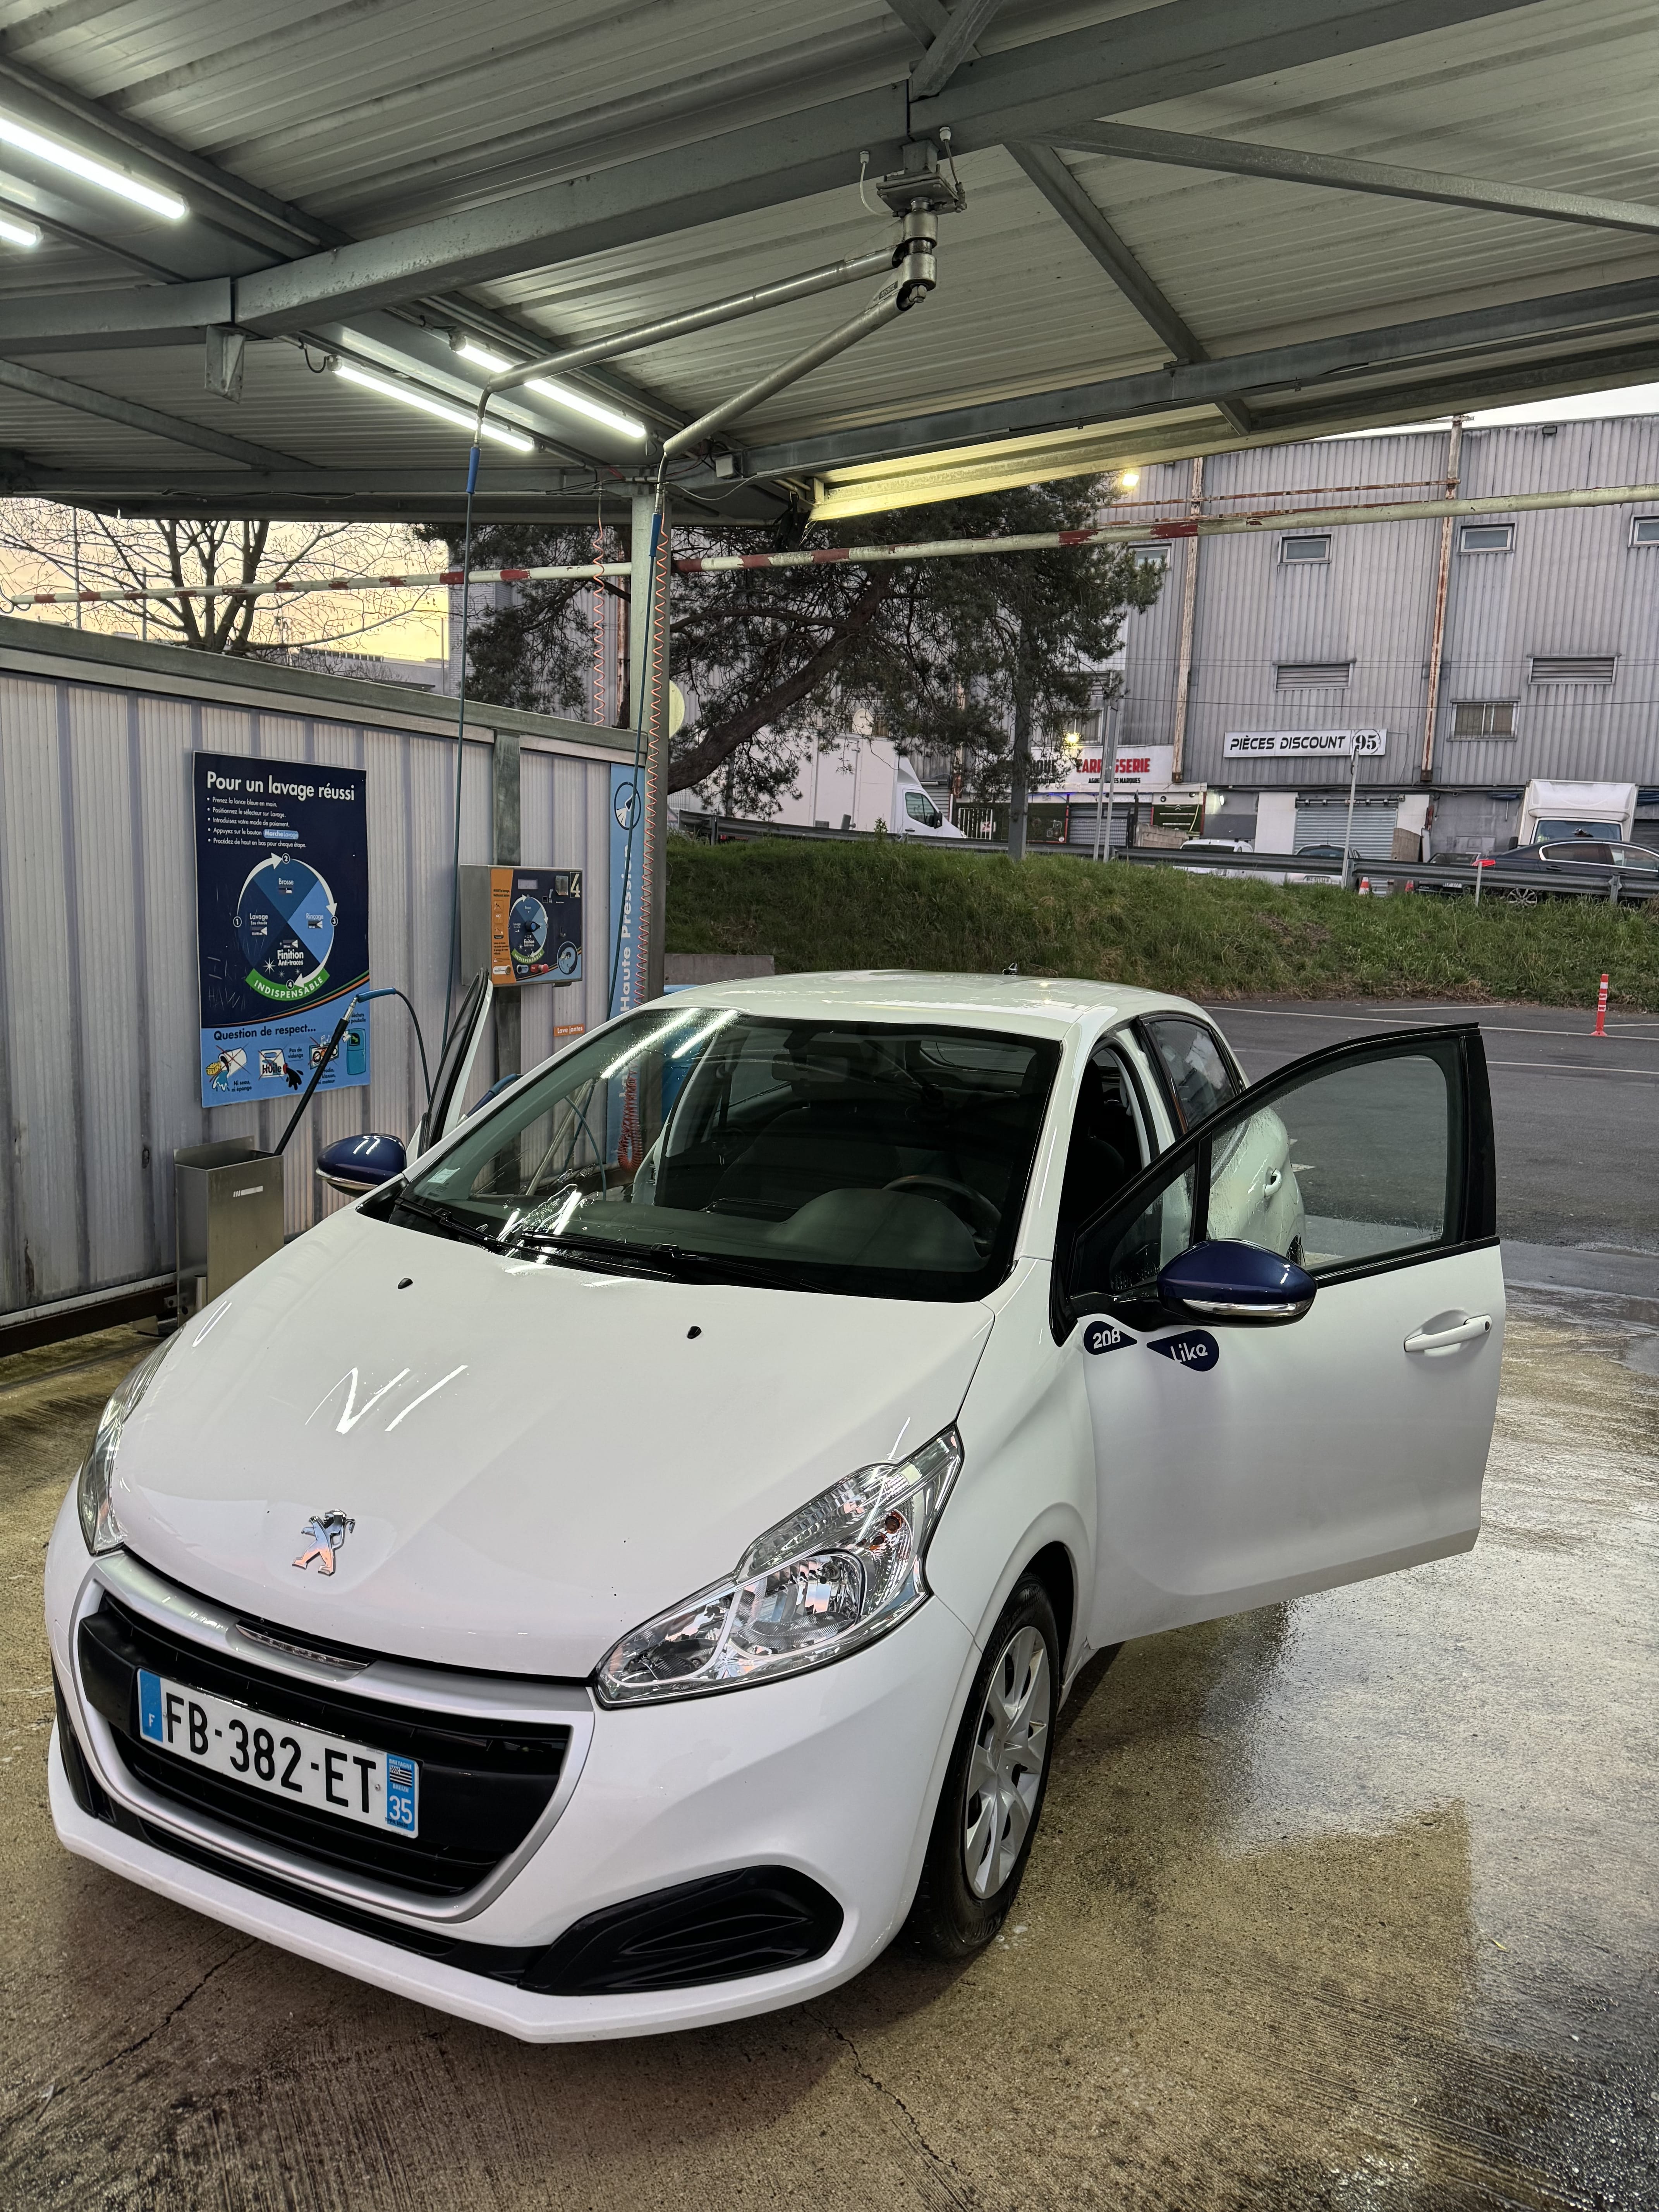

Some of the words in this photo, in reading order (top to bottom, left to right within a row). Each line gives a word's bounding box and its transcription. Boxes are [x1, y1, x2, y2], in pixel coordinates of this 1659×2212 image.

[1230, 735, 1275, 750] PIÈCES
[1280, 736, 1346, 749] DISCOUNT
[1355, 735, 1377, 750] 95
[208, 771, 241, 790] Pour
[246, 780, 263, 792] un
[269, 775, 314, 801] lavage
[319, 783, 354, 800] réussi
[278, 840, 293, 848] chaque
[570, 873, 581, 897] 4
[277, 949, 304, 960] Finition
[514, 953, 542, 963] INDISPENSABLE
[254, 976, 323, 998] INDISPENSABLE
[620, 946, 630, 1012] Haute
[214, 1028, 257, 1041] Question
[261, 1026, 272, 1036] de
[275, 1024, 316, 1036] respect...
[569, 1026, 583, 1034] jantes
[262, 1062, 282, 1074] Huile
[1092, 1328, 1121, 1349] 208
[148, 1713, 155, 1727] F
[166, 1692, 376, 1814] FB-382-ET
[389, 1758, 412, 1770] BRETAGNE
[393, 1783, 409, 1793] BREIZH
[389, 1795, 412, 1824] 35
